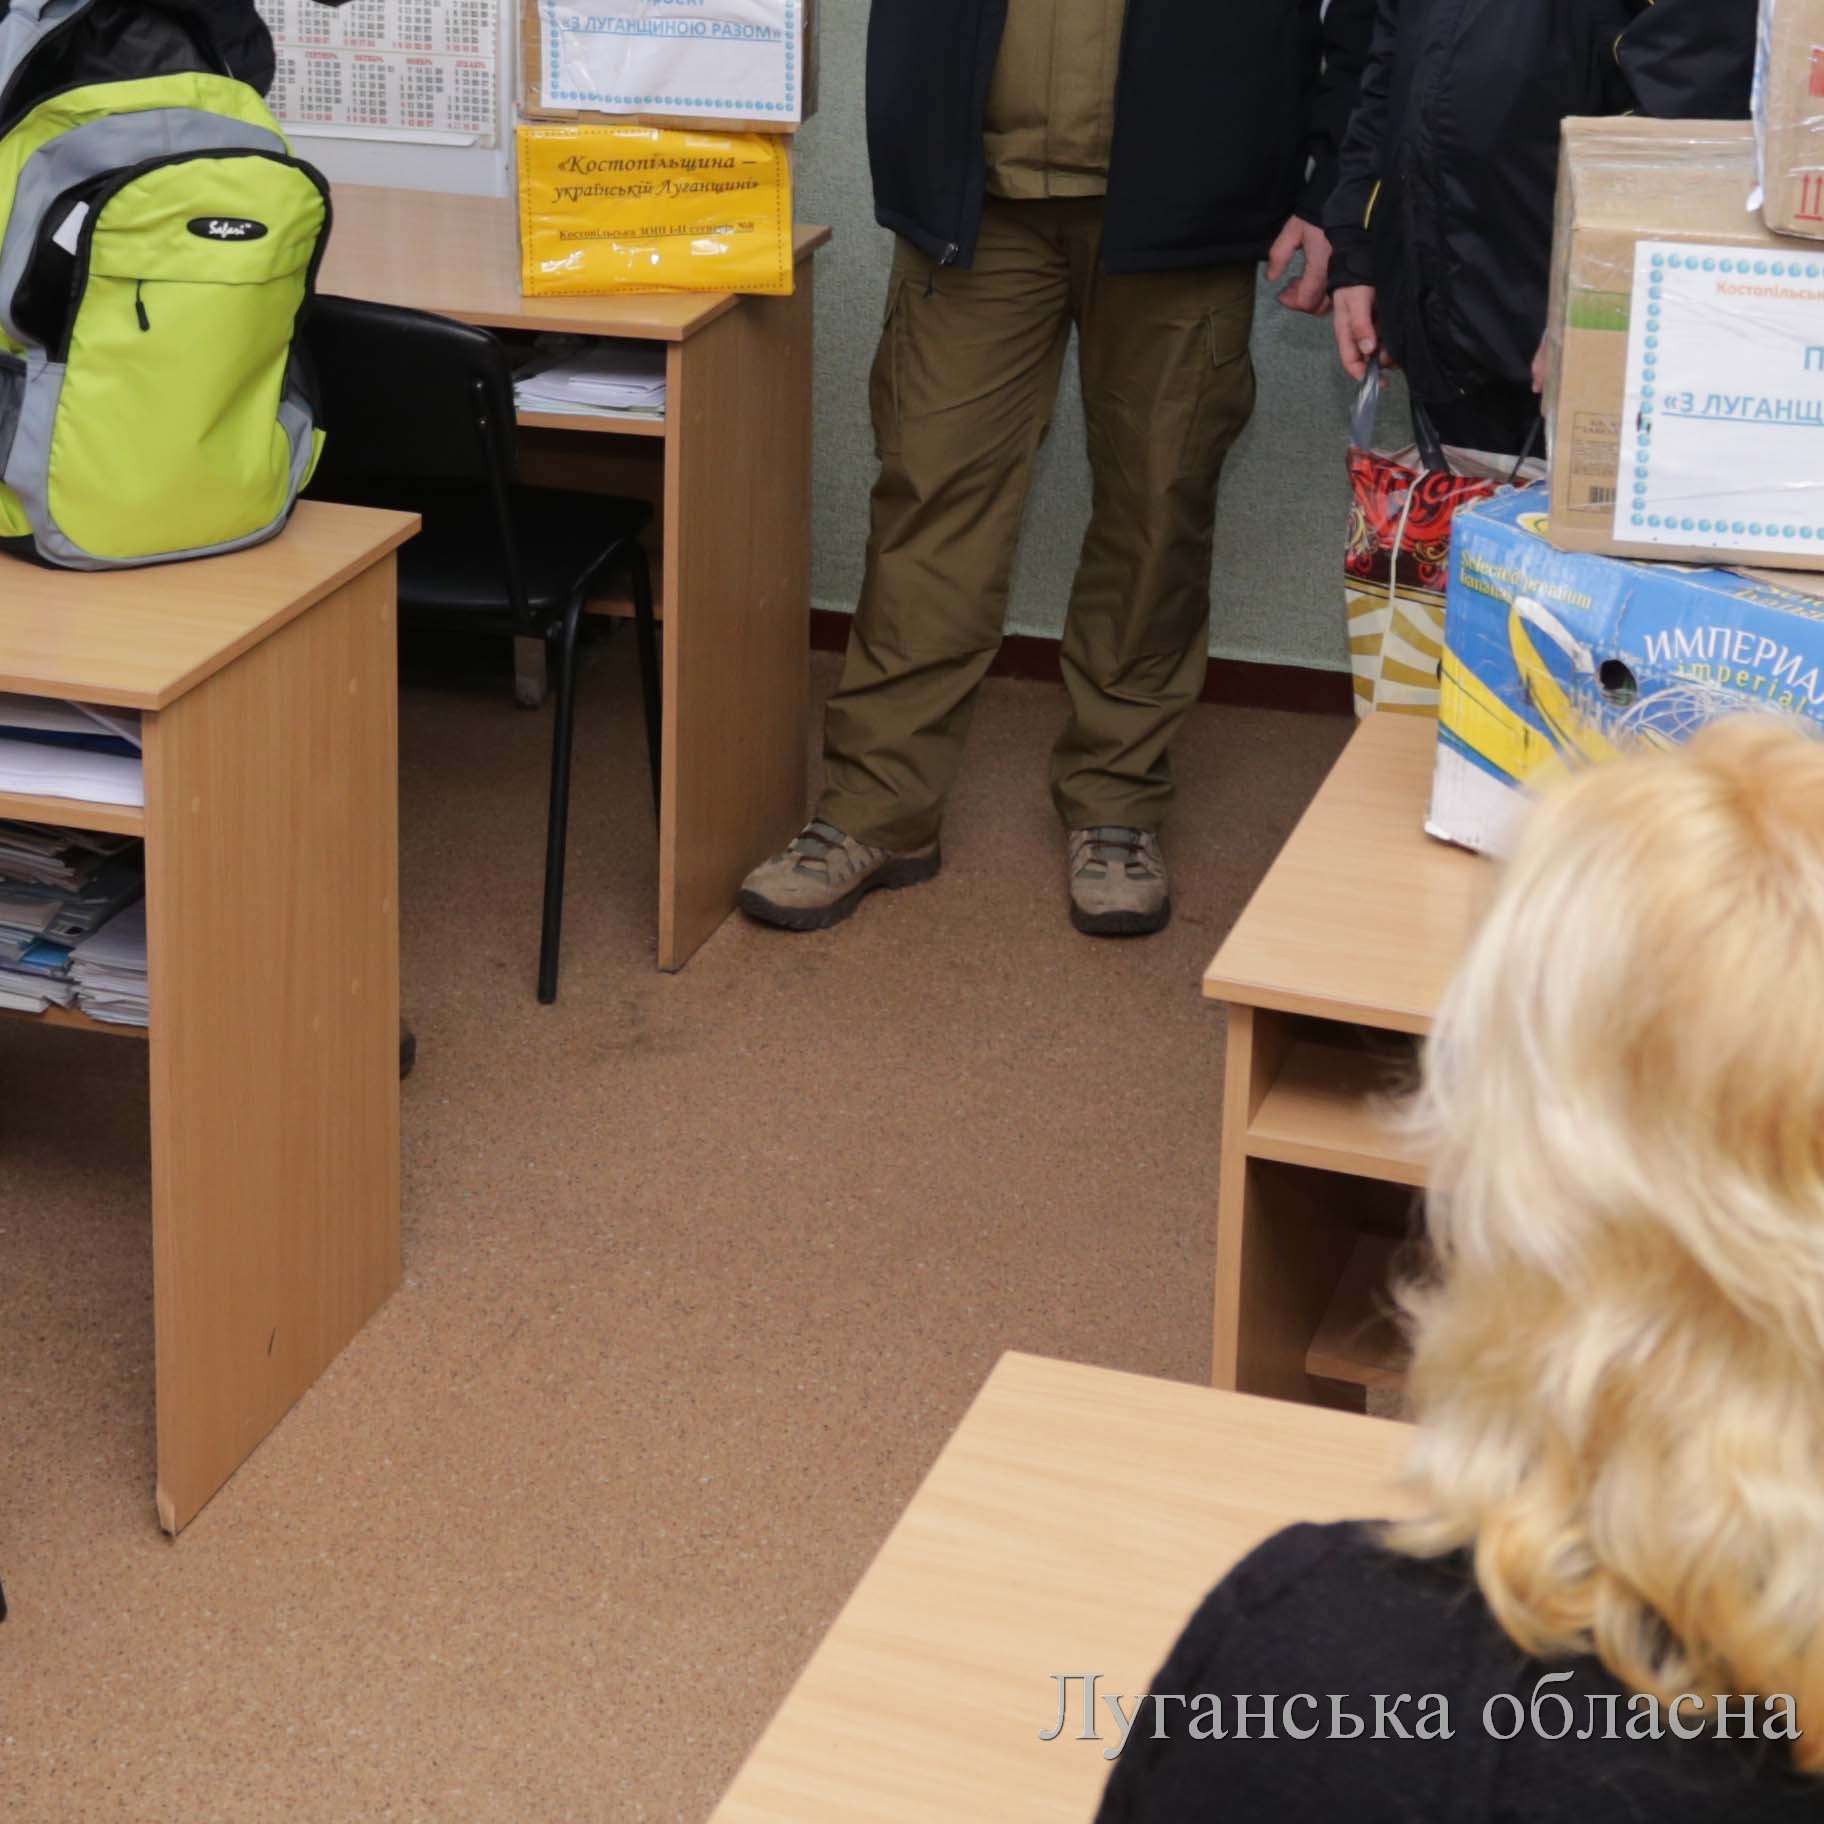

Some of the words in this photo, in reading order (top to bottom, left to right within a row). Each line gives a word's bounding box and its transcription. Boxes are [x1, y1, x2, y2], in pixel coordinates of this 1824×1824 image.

[586, 16, 706, 37] ЛУГАНЩИНОЮ
[712, 22, 782, 40] РАЗОМ»
[558, 154, 735, 175] «Костопільщина
[552, 181, 653, 203] українській
[656, 177, 760, 199] Луганщині»
[209, 220, 245, 238] Safari
[1664, 391, 1694, 413] «З
[1675, 660, 1808, 716] imperial
